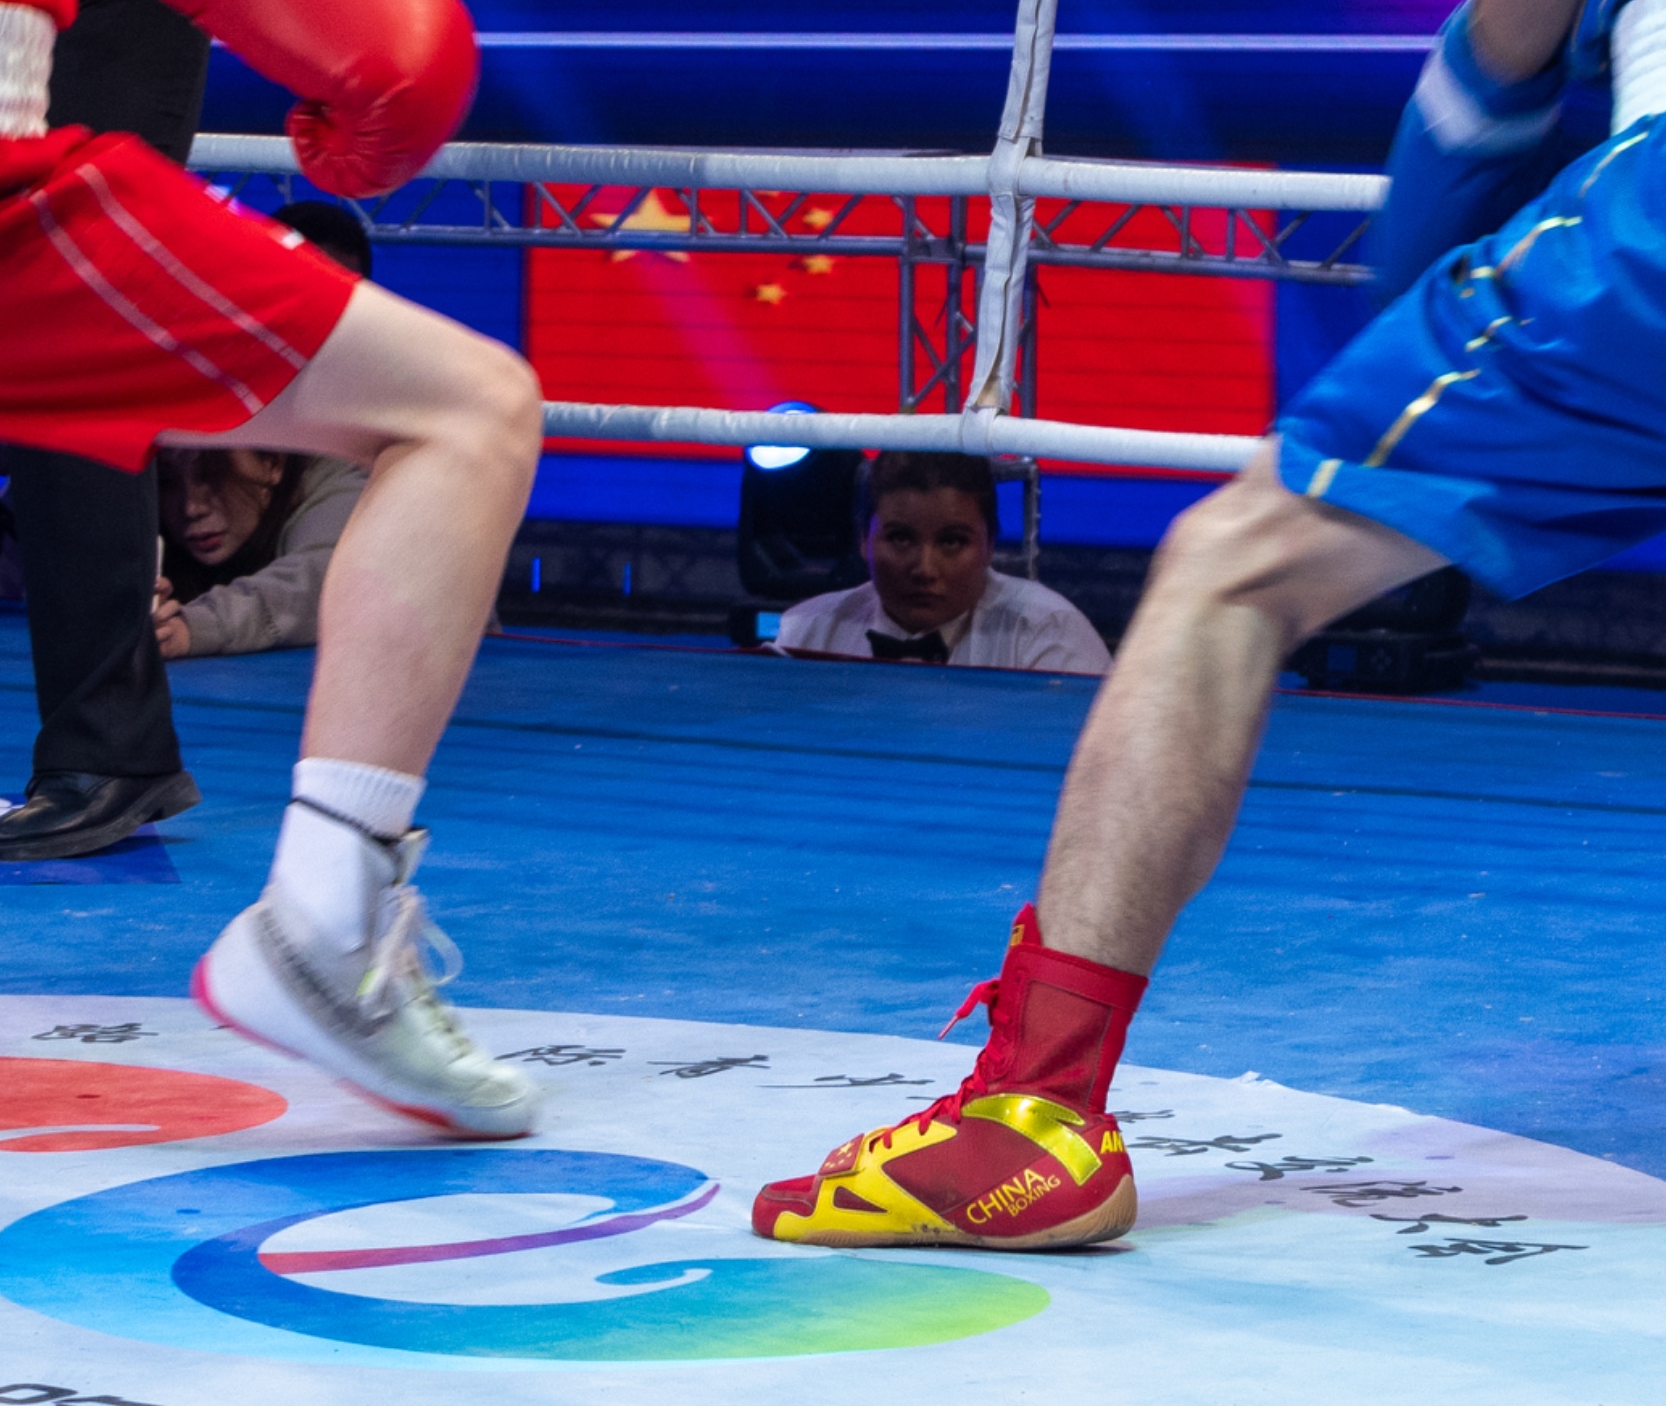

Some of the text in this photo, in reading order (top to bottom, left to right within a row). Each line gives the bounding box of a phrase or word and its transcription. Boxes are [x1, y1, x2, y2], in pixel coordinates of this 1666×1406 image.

[1100, 1130, 1128, 1154] AN
[967, 1168, 1044, 1224] CHINA
[1005, 1174, 1061, 1217] BOXING
